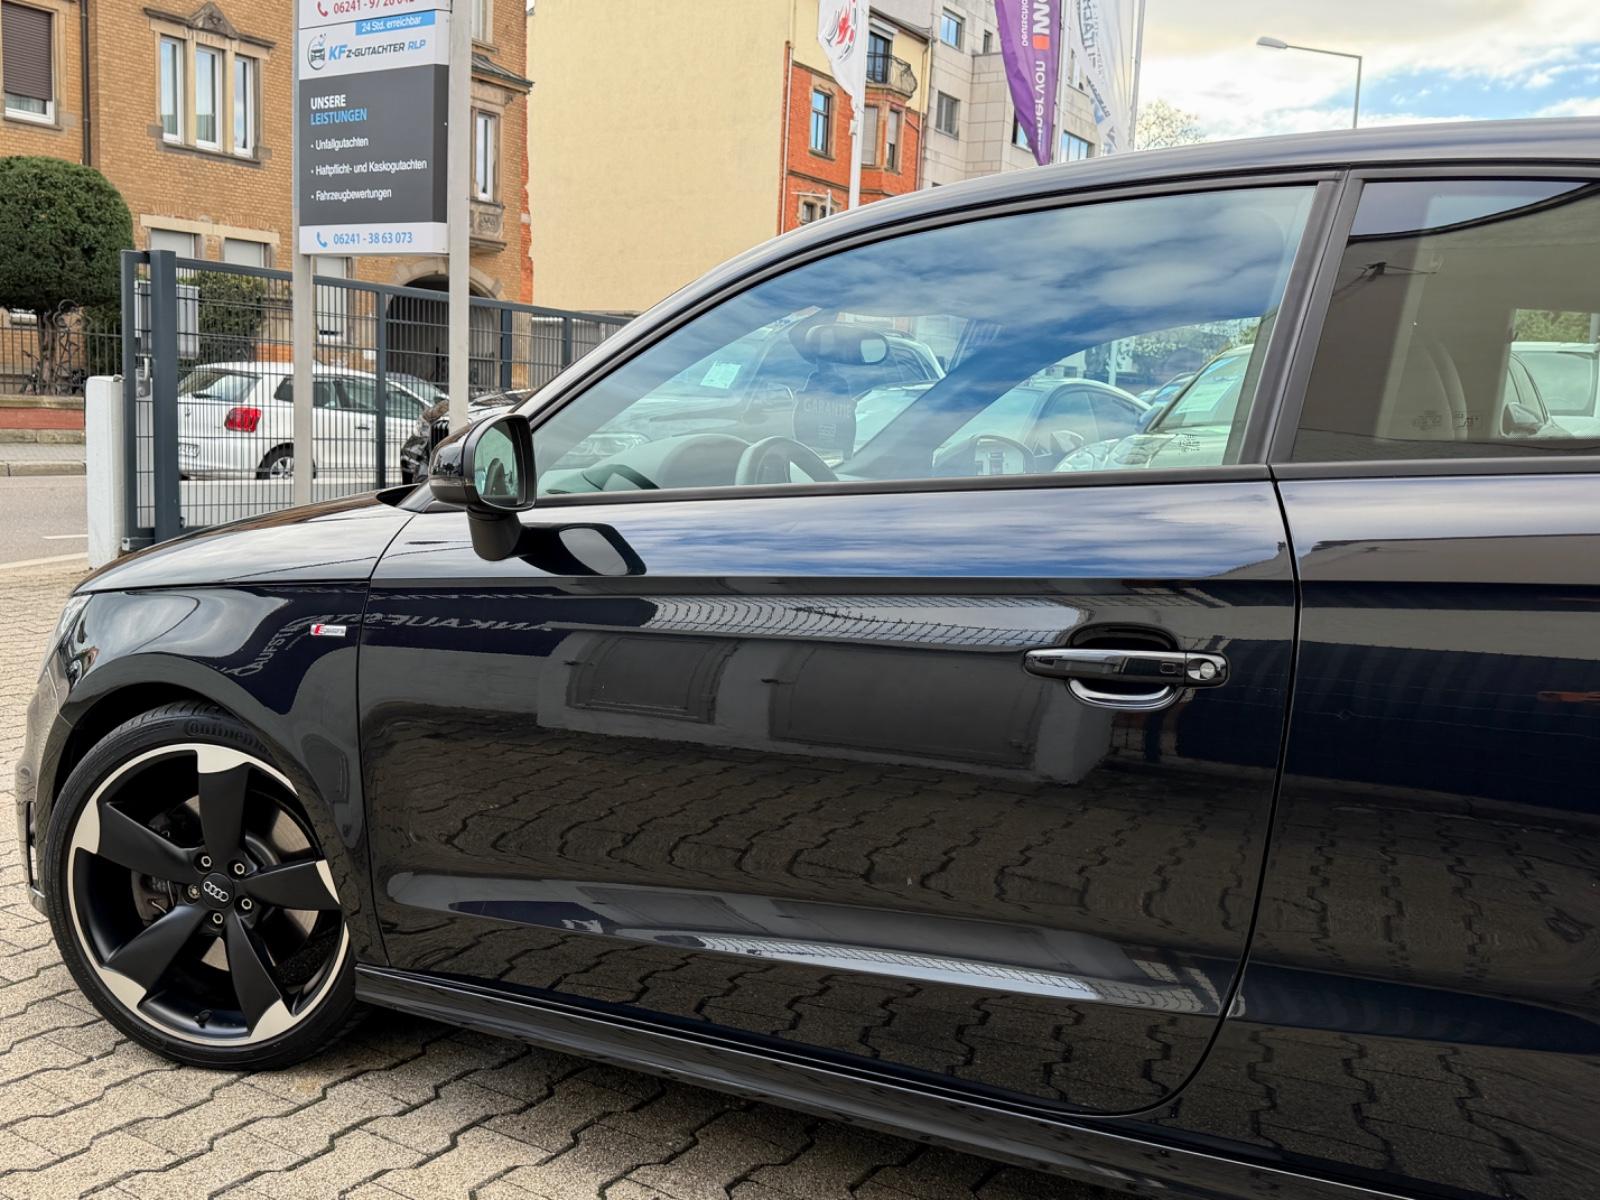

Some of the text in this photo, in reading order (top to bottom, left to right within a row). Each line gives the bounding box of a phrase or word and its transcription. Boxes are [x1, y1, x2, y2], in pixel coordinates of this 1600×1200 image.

[333, 0, 361, 14] 06241
[361, 15, 422, 32] 24 Std. erreichbar
[407, 39, 426, 51] RLP
[310, 94, 347, 110] UNSERE
[310, 107, 368, 126] LEISTUNGEN
[315, 136, 369, 152] Unfallgutachten
[315, 159, 428, 177] Haftpflicht- und Kaskogutachten
[315, 188, 392, 203] Fahrzeugbewertungen
[333, 233, 360, 245] 06241
[368, 232, 380, 245] 38
[381, 232, 393, 244] 63
[395, 231, 413, 244] 073
